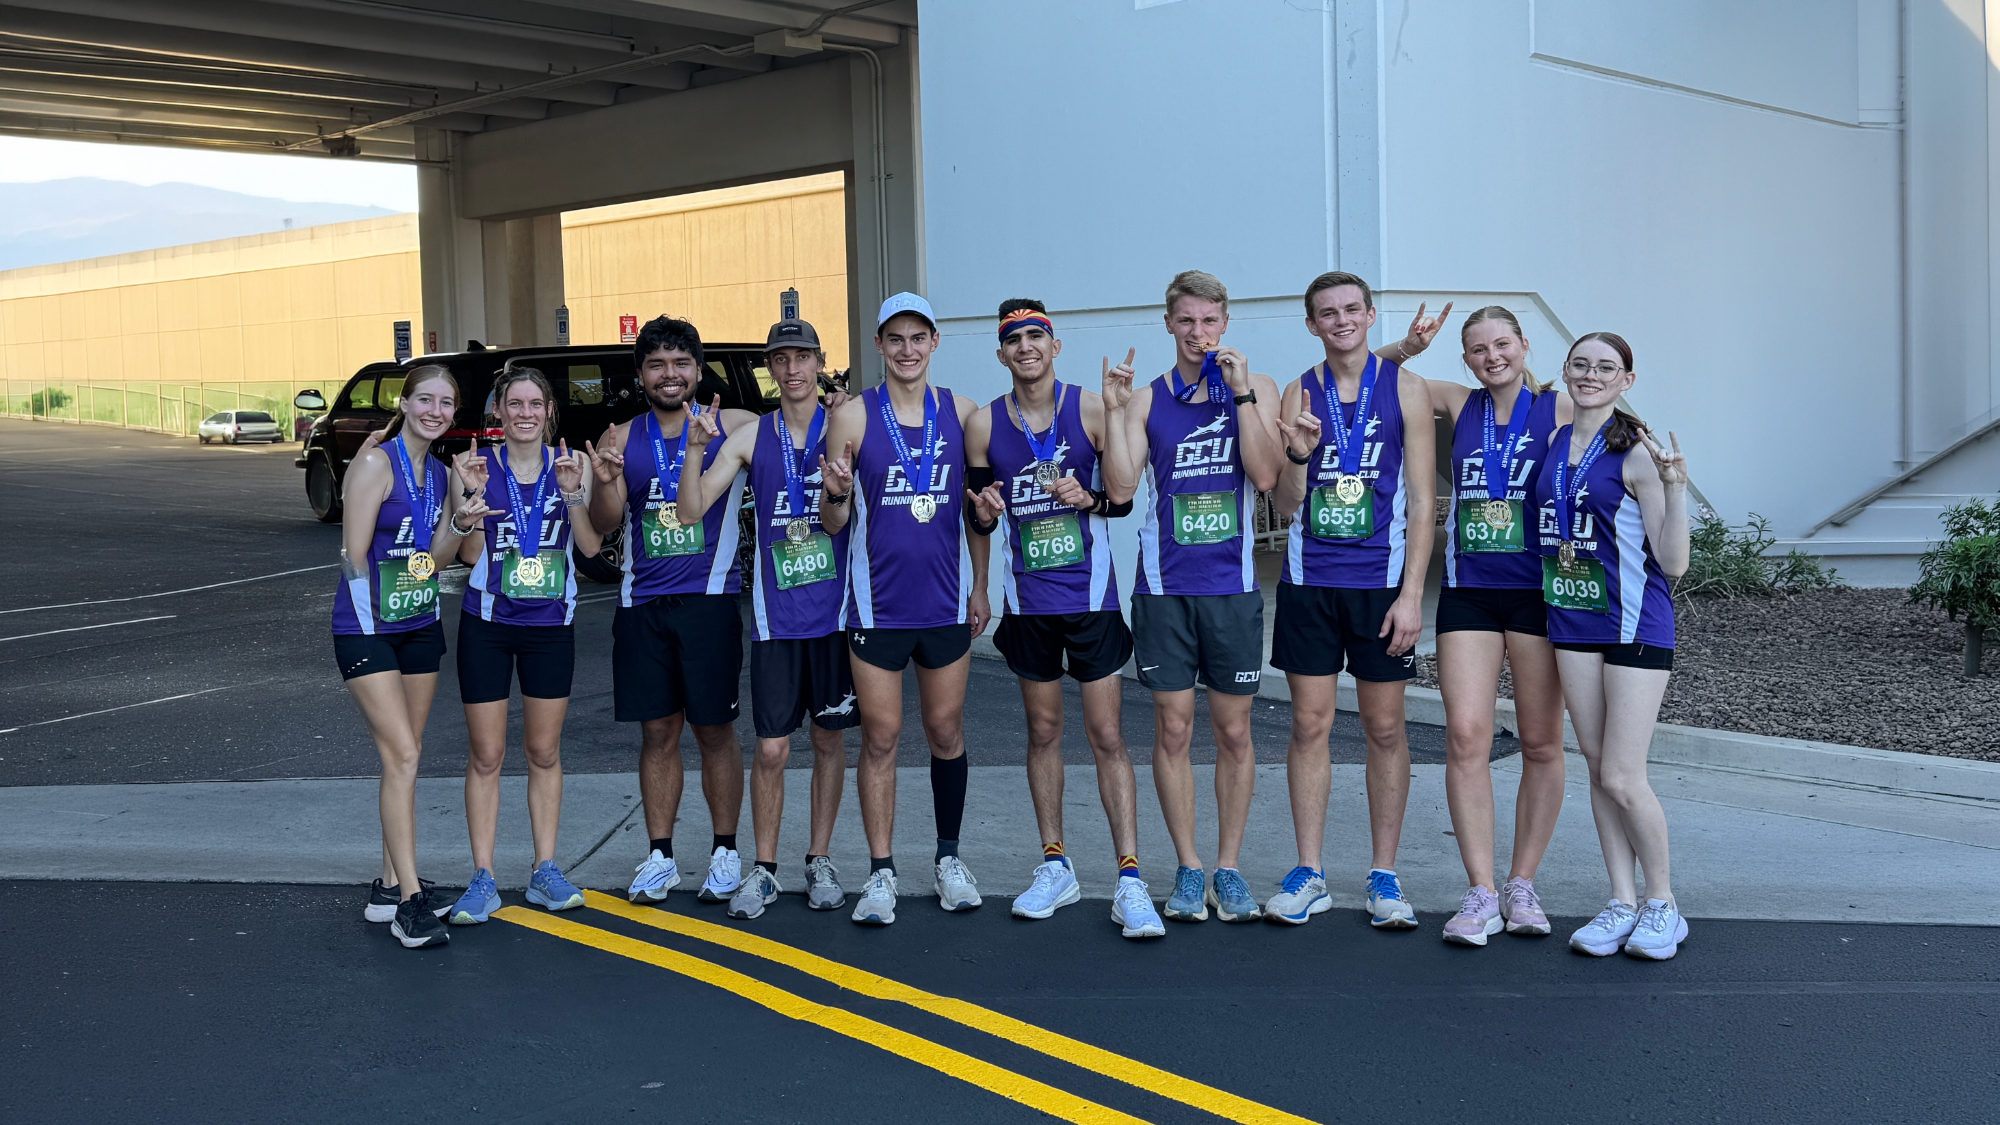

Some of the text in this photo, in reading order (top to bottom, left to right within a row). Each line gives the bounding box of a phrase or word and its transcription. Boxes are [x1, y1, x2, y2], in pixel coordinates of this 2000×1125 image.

[1175, 437, 1234, 468] GCU
[1321, 442, 1384, 469] GU
[885, 465, 951, 492] GU
[1172, 465, 1234, 480] RUNNING CLUB
[1461, 458, 1536, 486] GU
[881, 495, 950, 506] RUNNIN LUB
[1506, 490, 1527, 500] LUB
[1182, 513, 1230, 533] 6420
[1318, 507, 1366, 525] 6551
[1539, 507, 1595, 538] GU
[496, 520, 563, 548] GU
[650, 526, 695, 547] 6161
[1028, 535, 1076, 558] 6768
[782, 552, 828, 577] 6480
[509, 569, 556, 588] 61
[1552, 577, 1600, 599] 6039
[388, 587, 434, 609] 6790
[1235, 670, 1260, 682] GCU
